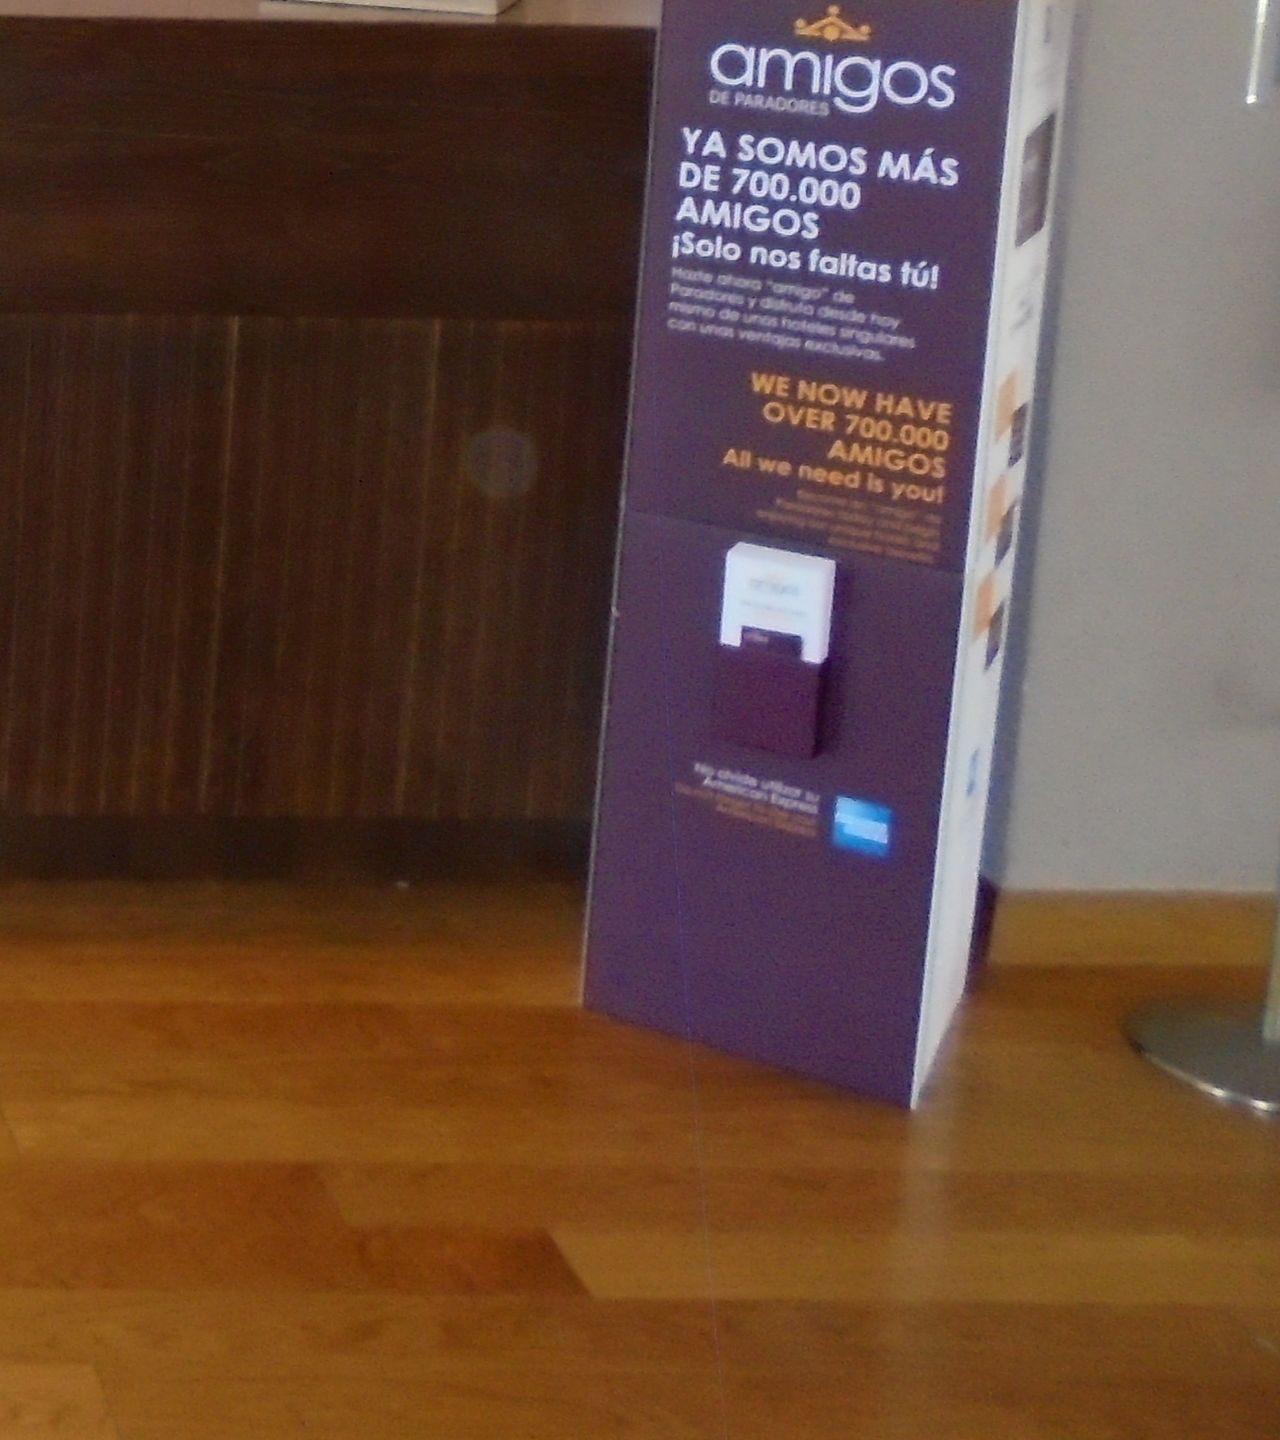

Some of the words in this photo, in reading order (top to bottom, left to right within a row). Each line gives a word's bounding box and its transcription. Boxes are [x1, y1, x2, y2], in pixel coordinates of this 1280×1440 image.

[709, 43, 957, 114] amigos
[709, 89, 729, 105] DE
[734, 92, 830, 116] PARADORES
[681, 127, 726, 159] YA
[737, 133, 868, 176] SOMOS
[877, 147, 960, 187] MÁS
[679, 161, 721, 191] DE
[731, 167, 862, 210] 700.000
[675, 196, 820, 240] AMIGOS
[671, 231, 742, 262] ¡Solo
[750, 245, 801, 269] nos
[808, 248, 892, 282] faltas
[901, 260, 940, 290] tú!
[670, 282, 745, 305] Paradores
[751, 372, 789, 398] WE
[797, 379, 868, 410] NOW
[874, 392, 953, 424] HAVE
[762, 401, 835, 432] OVER
[845, 413, 950, 452] 700.000
[722, 447, 752, 469] All
[757, 457, 792, 477] we
[798, 463, 862, 489] need
[867, 471, 885, 494] is
[891, 481, 945, 504] you!
[826, 439, 947, 479] AMIGOS
